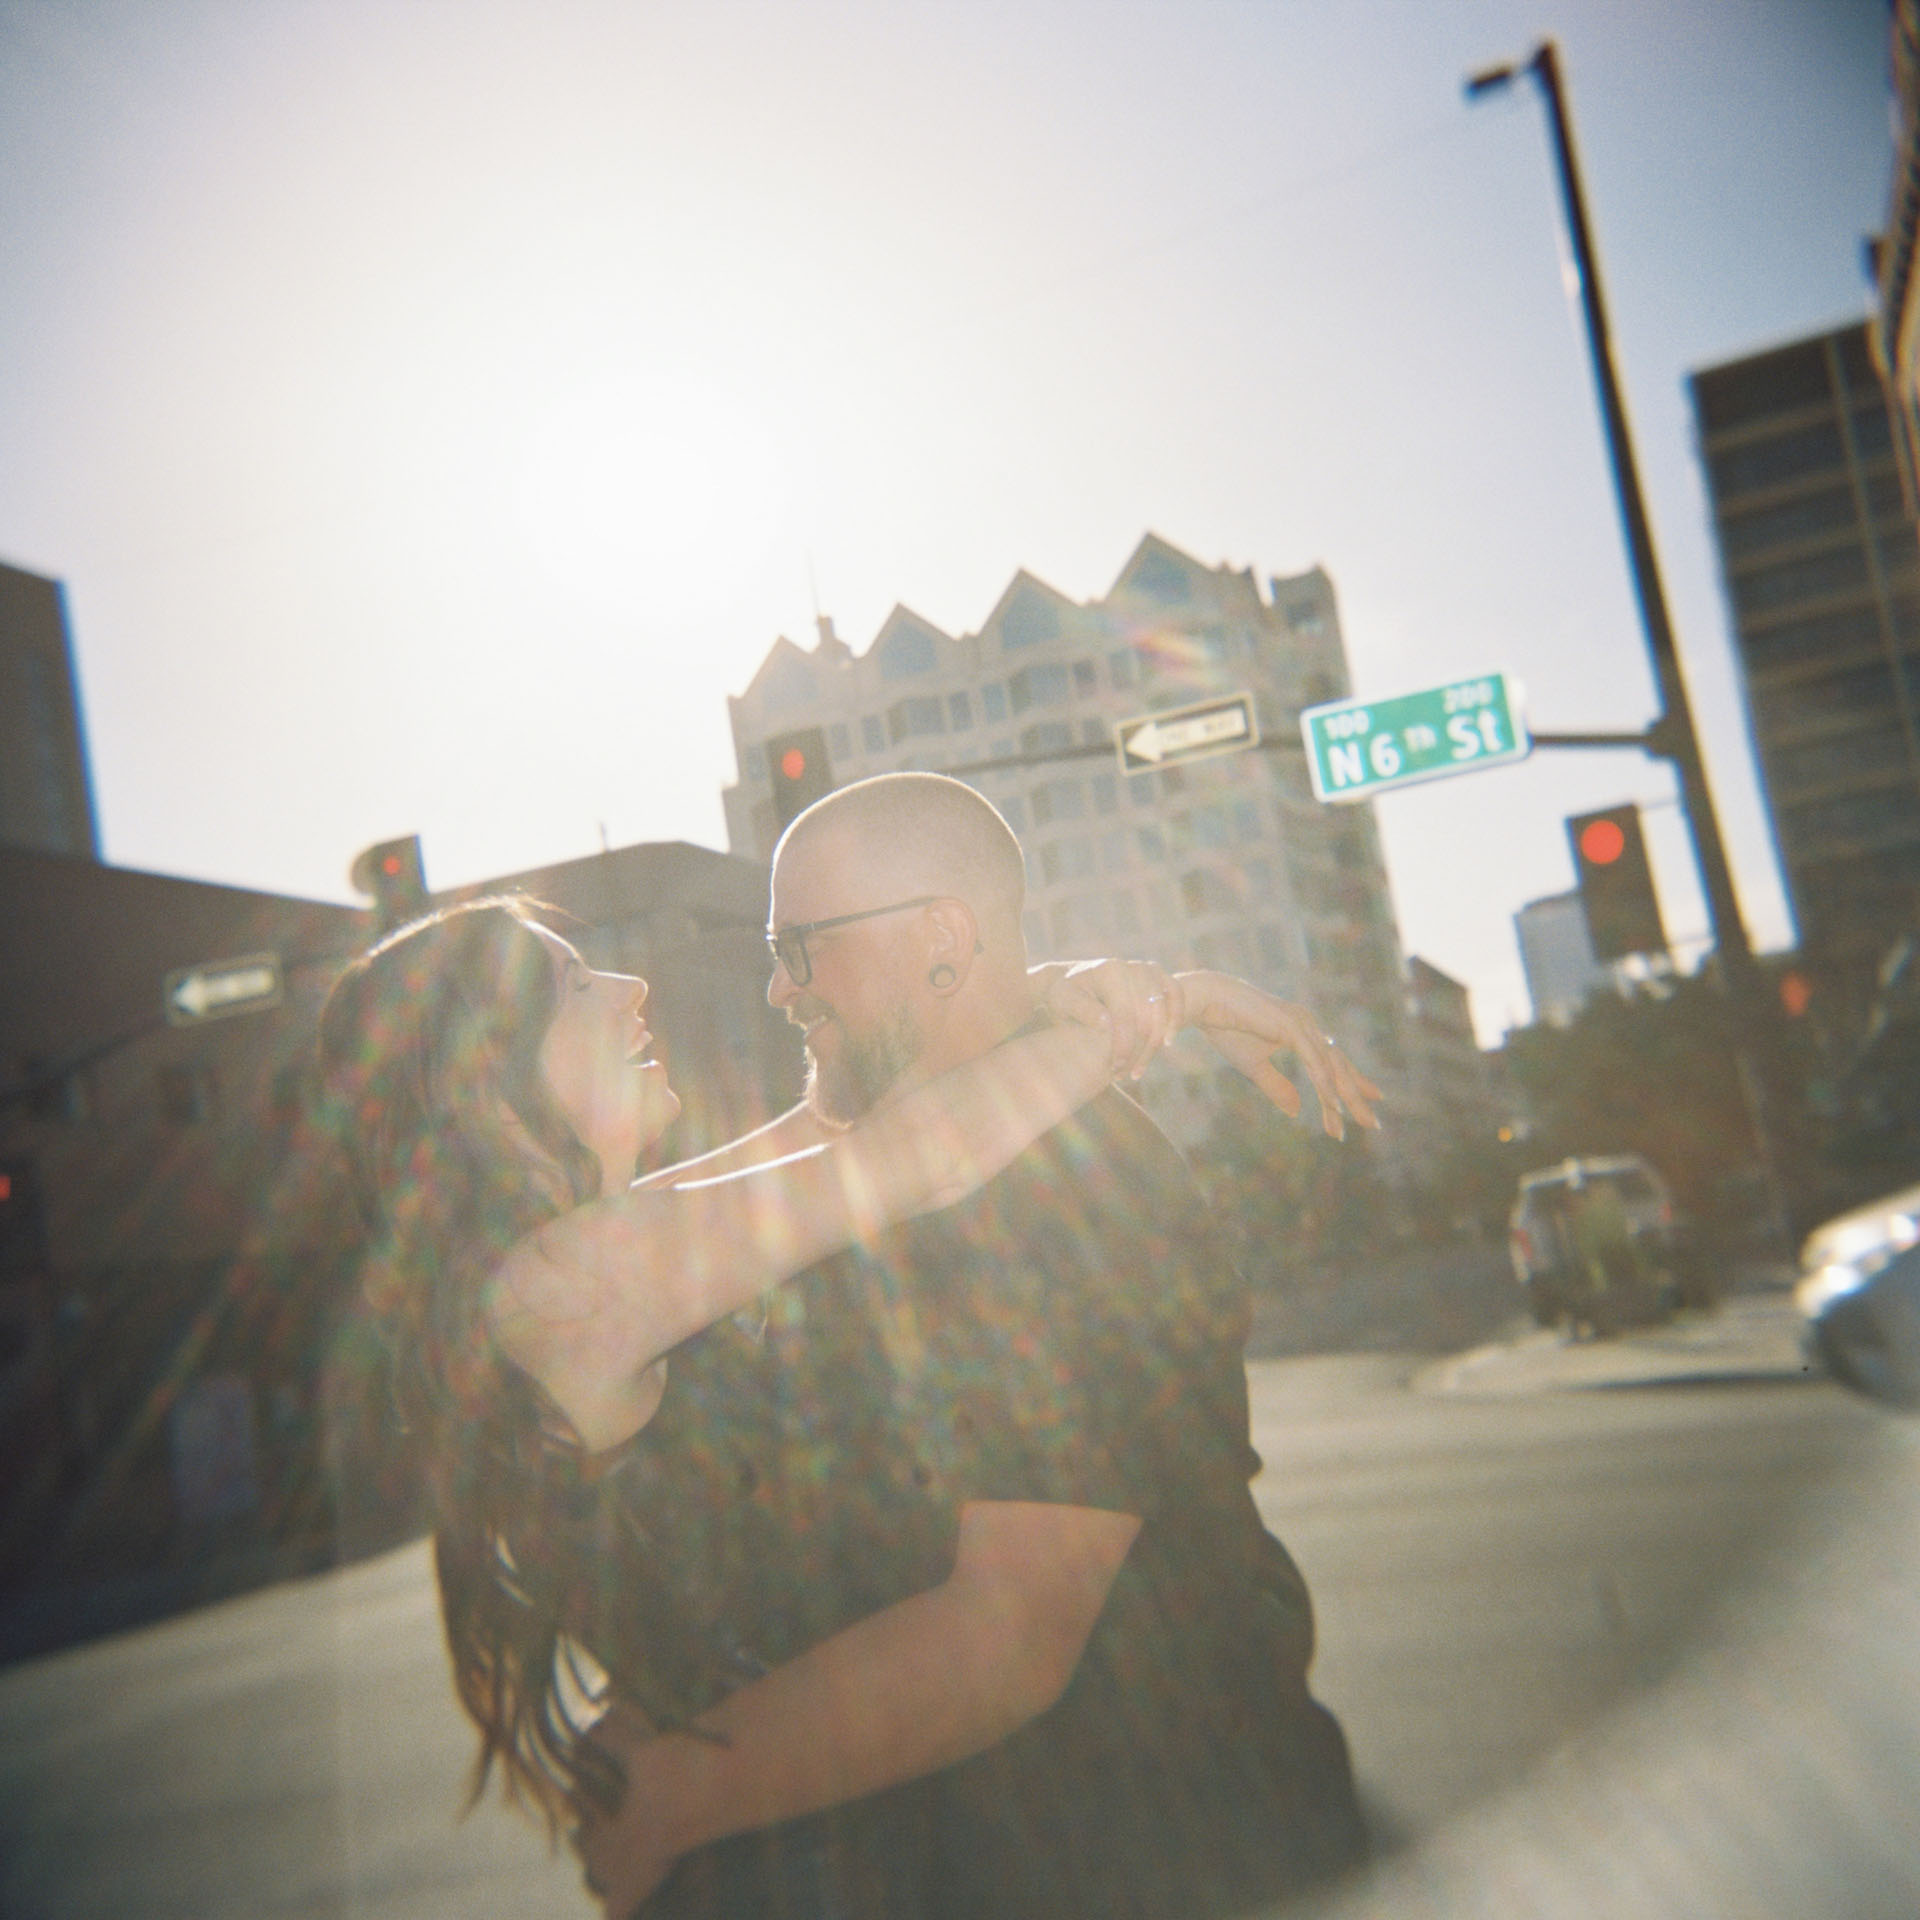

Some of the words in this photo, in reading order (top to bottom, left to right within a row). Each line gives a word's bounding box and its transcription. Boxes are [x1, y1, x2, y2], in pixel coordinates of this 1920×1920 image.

[1324, 710, 1370, 740] 100
[1328, 742, 1364, 787] N
[1446, 708, 1503, 760] St
